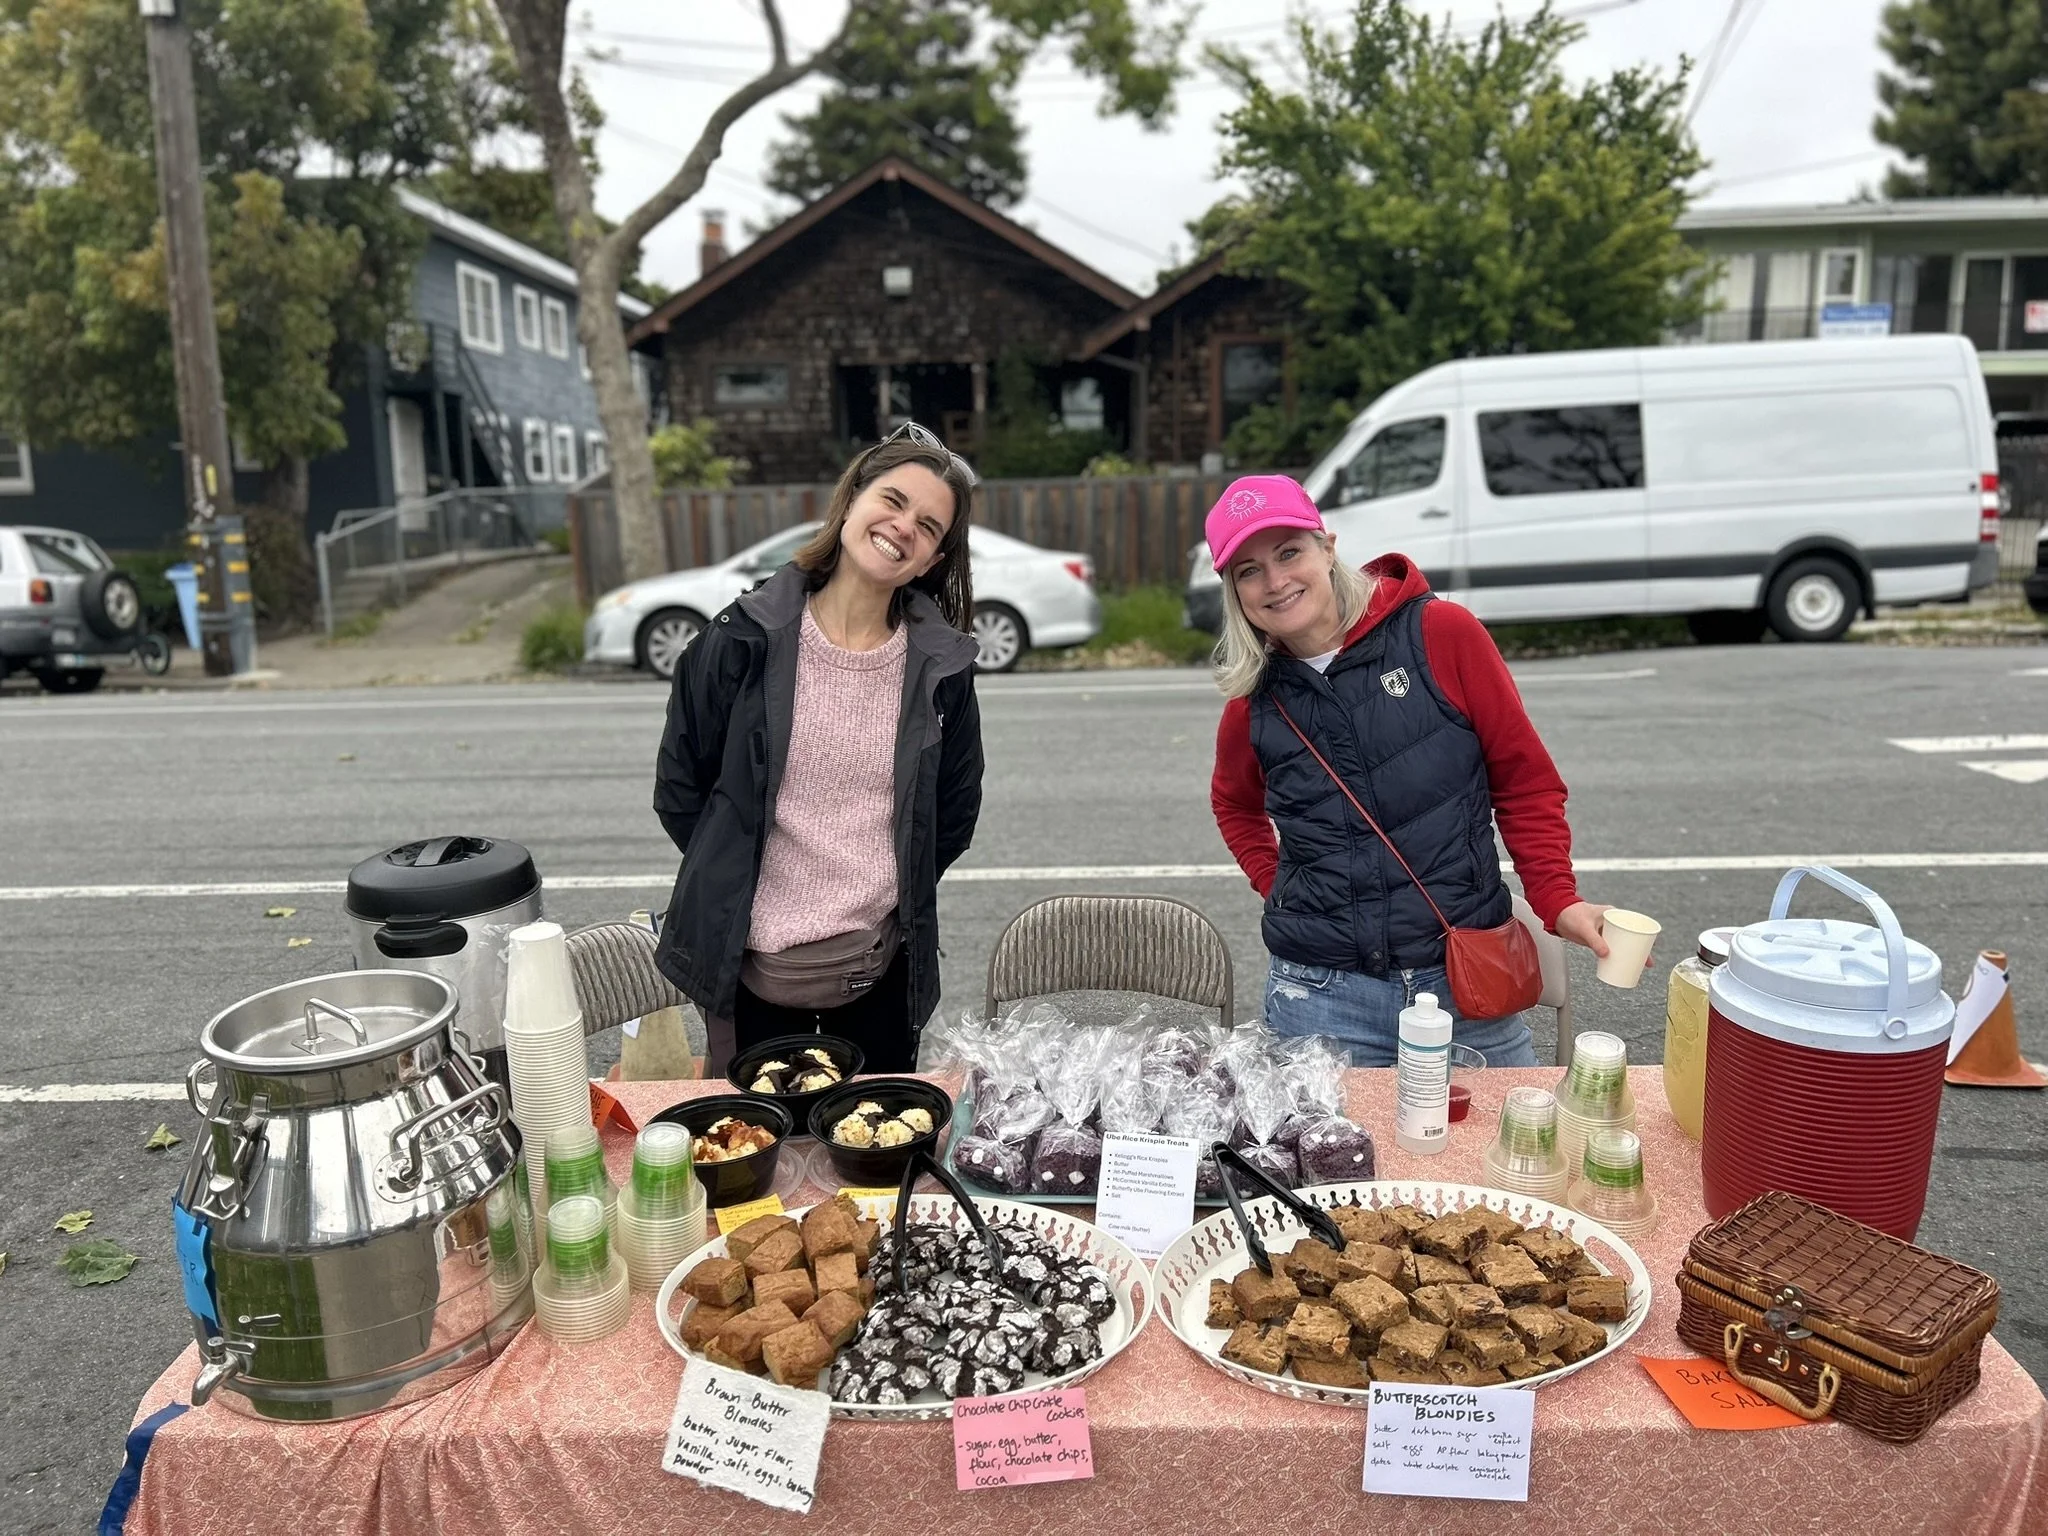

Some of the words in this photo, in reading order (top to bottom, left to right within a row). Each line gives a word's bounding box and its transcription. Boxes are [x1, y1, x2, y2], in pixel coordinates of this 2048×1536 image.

[1106, 1133, 1121, 1141] Ube
[1139, 1137, 1165, 1146] Krispie
[1167, 1139, 1189, 1147] Treats
[1676, 1369, 1734, 1387] BAK
[705, 1378, 740, 1404] Brown
[752, 1393, 792, 1417] Butter
[1374, 1388, 1478, 1407] BUTTERSCOTCH
[957, 1401, 1005, 1418] Chocolate
[1008, 1398, 1031, 1414] Chip
[1046, 1406, 1085, 1422] Cookies
[1415, 1407, 1496, 1423] BLONDIES
[724, 1405, 773, 1434] Blondies
[1005, 1450, 1053, 1466] chocolate
[1402, 1445, 1423, 1457] eggs
[787, 1478, 814, 1505] baking
